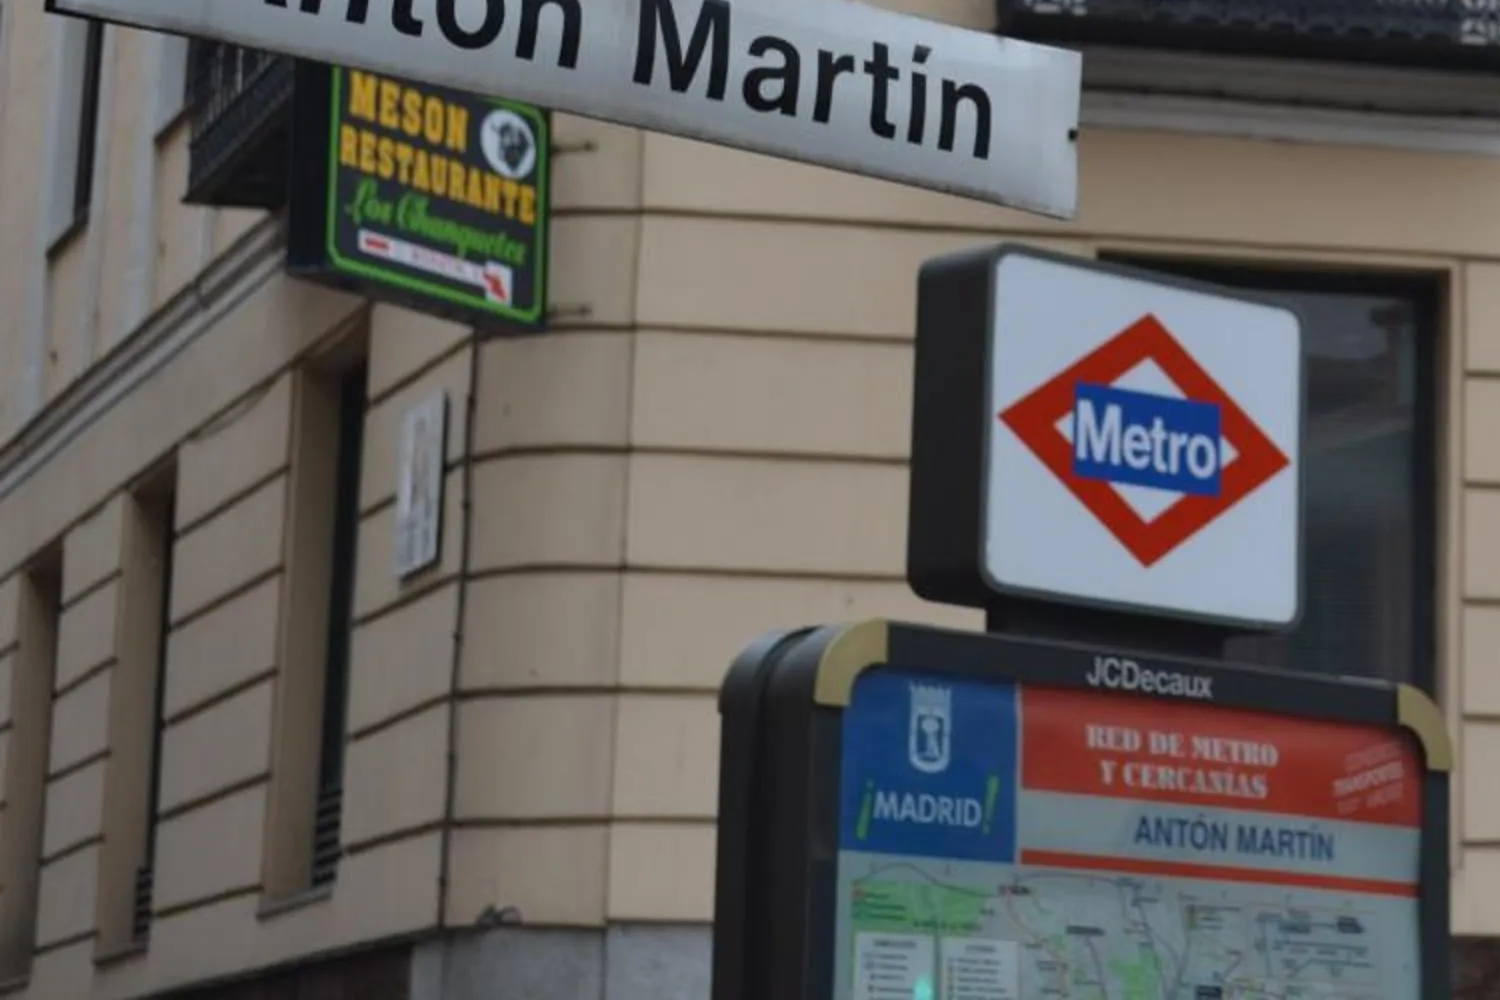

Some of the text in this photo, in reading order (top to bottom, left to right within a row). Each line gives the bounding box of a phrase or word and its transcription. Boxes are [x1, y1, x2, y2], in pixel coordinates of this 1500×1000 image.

[350, 70, 469, 153] MESON
[340, 123, 537, 226] RESTAURANTE
[1076, 399, 1217, 479] Metro
[1086, 656, 1214, 698] JCDecaux
[1086, 724, 1280, 768] RED DE METRO
[1100, 760, 1269, 799] Y CERCANÍAS
[1134, 813, 1336, 862] ANTÓN MARTÍN
